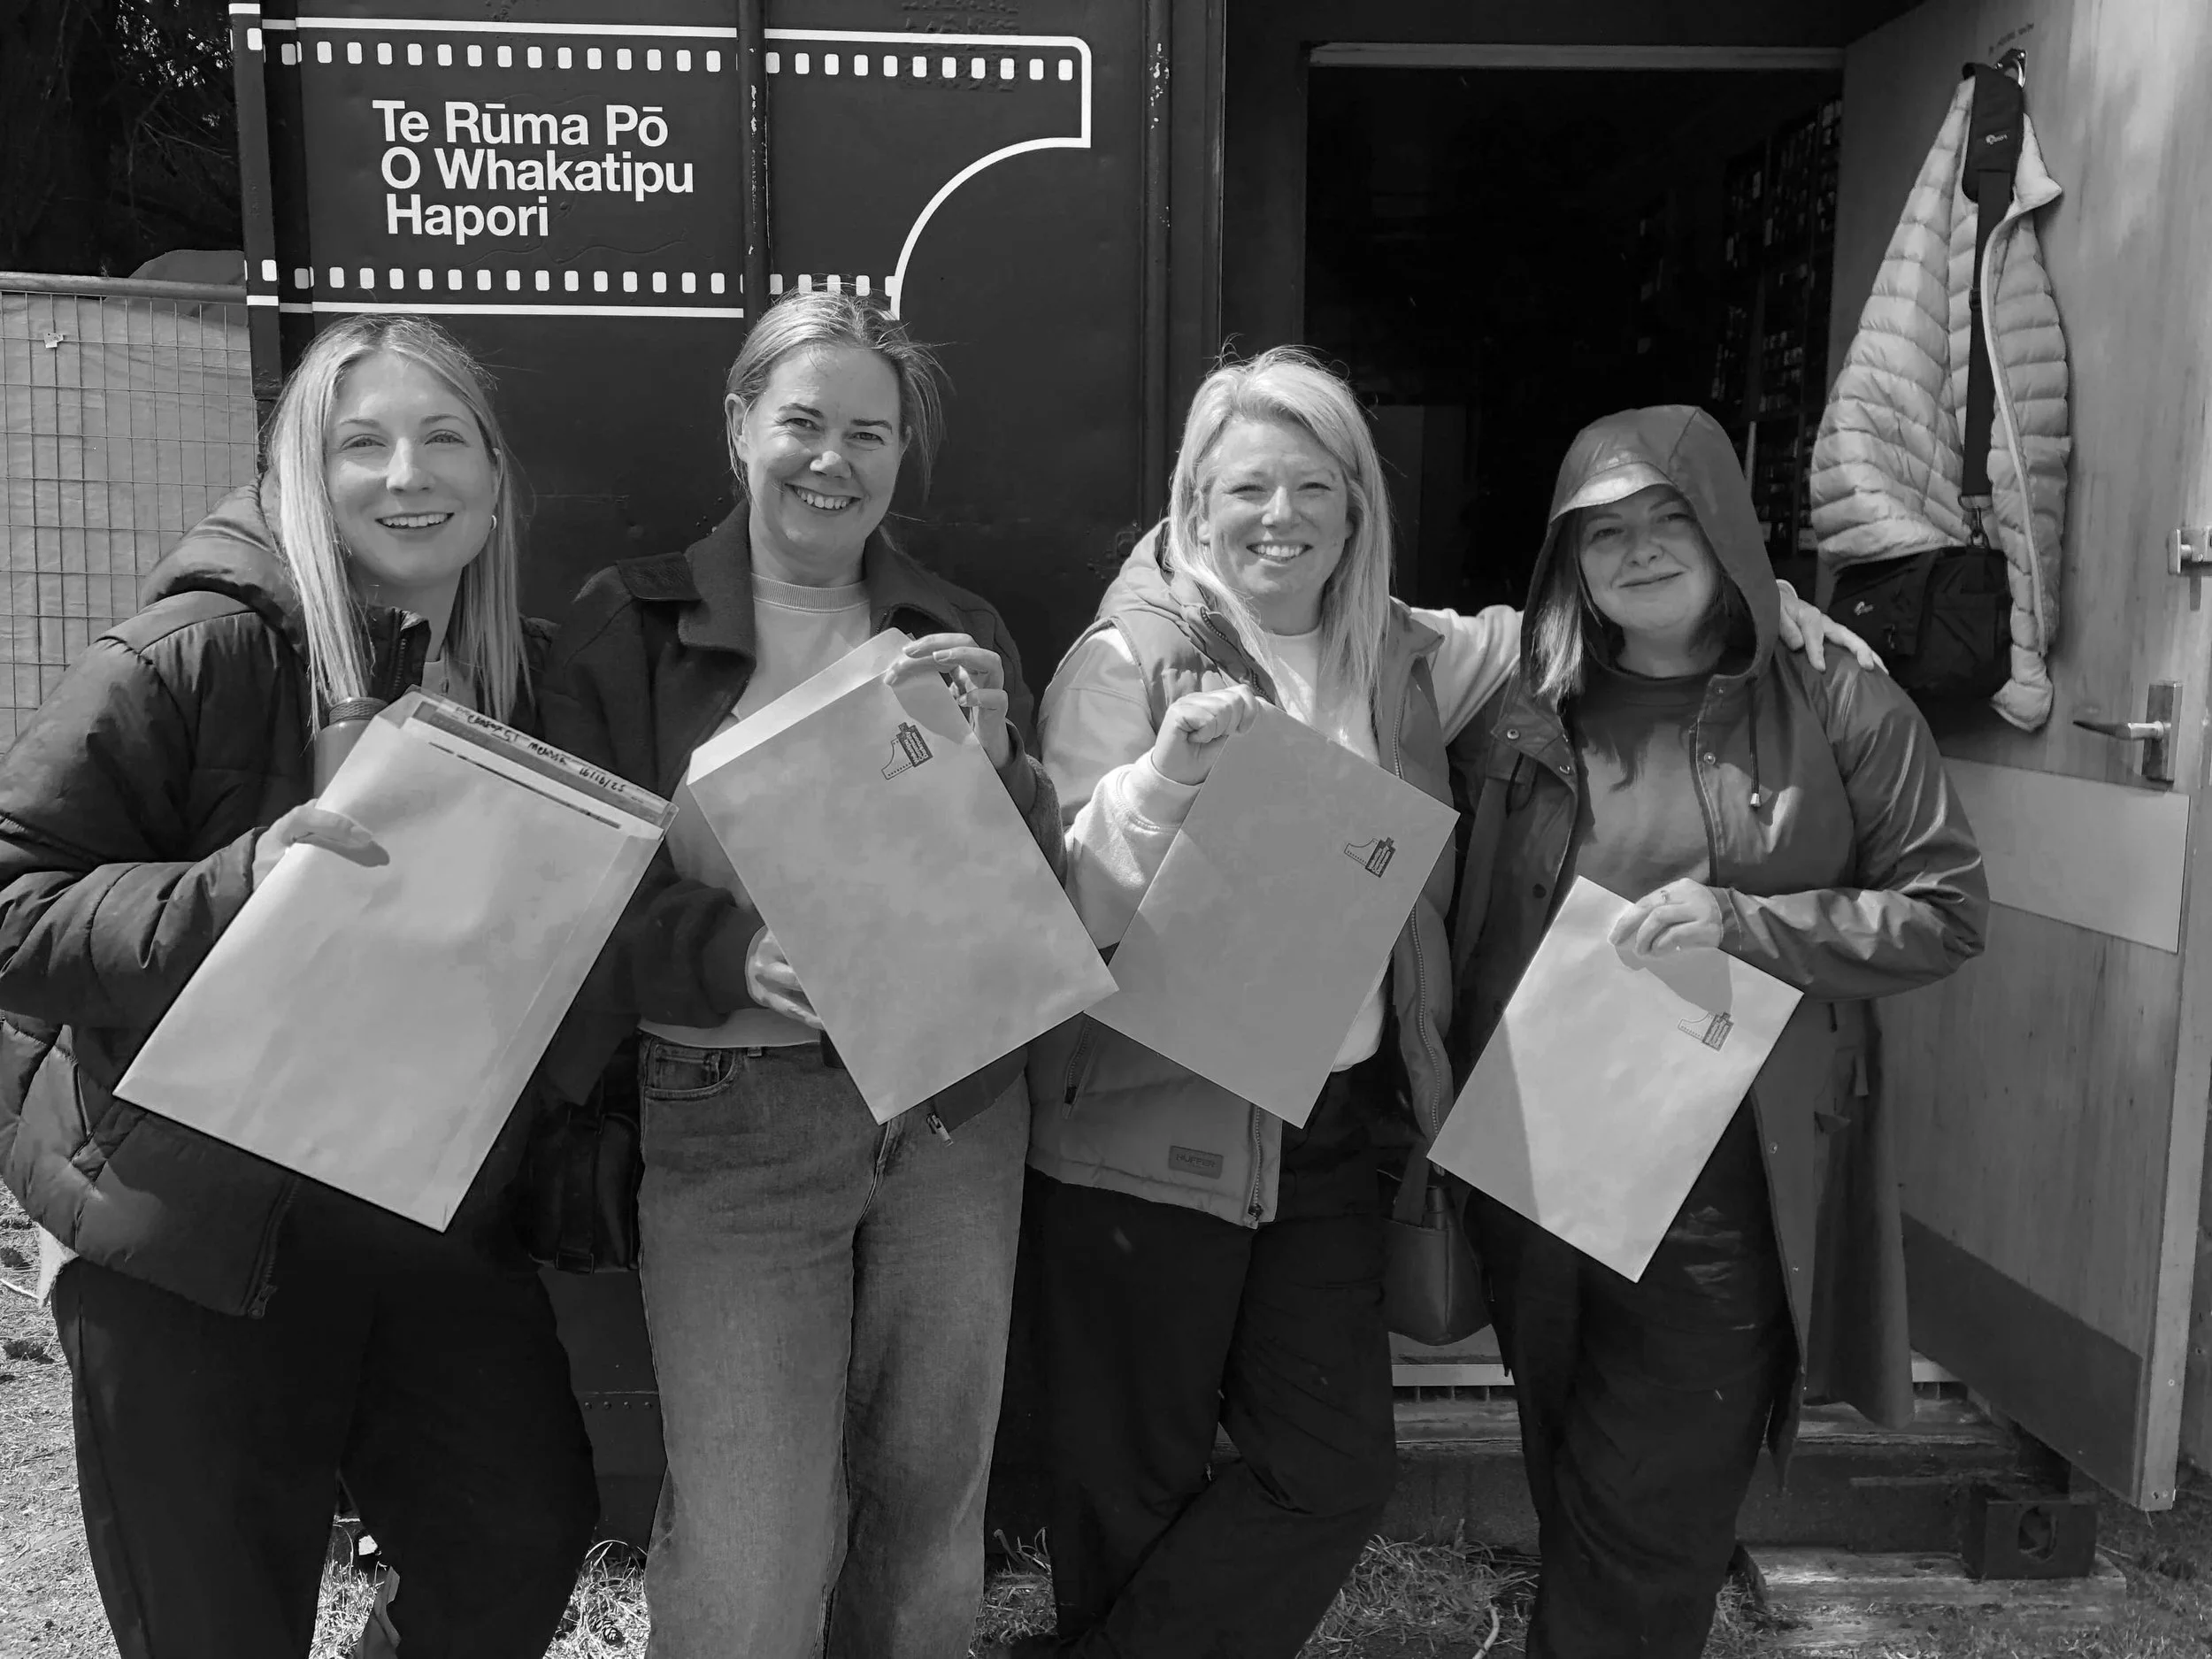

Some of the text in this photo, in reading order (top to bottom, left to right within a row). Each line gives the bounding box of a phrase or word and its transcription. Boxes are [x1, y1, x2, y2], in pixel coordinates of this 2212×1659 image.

[373, 99, 669, 147] Te Rūma Pō
[380, 146, 694, 202] O Whakatipu
[386, 193, 549, 245] Hapori
